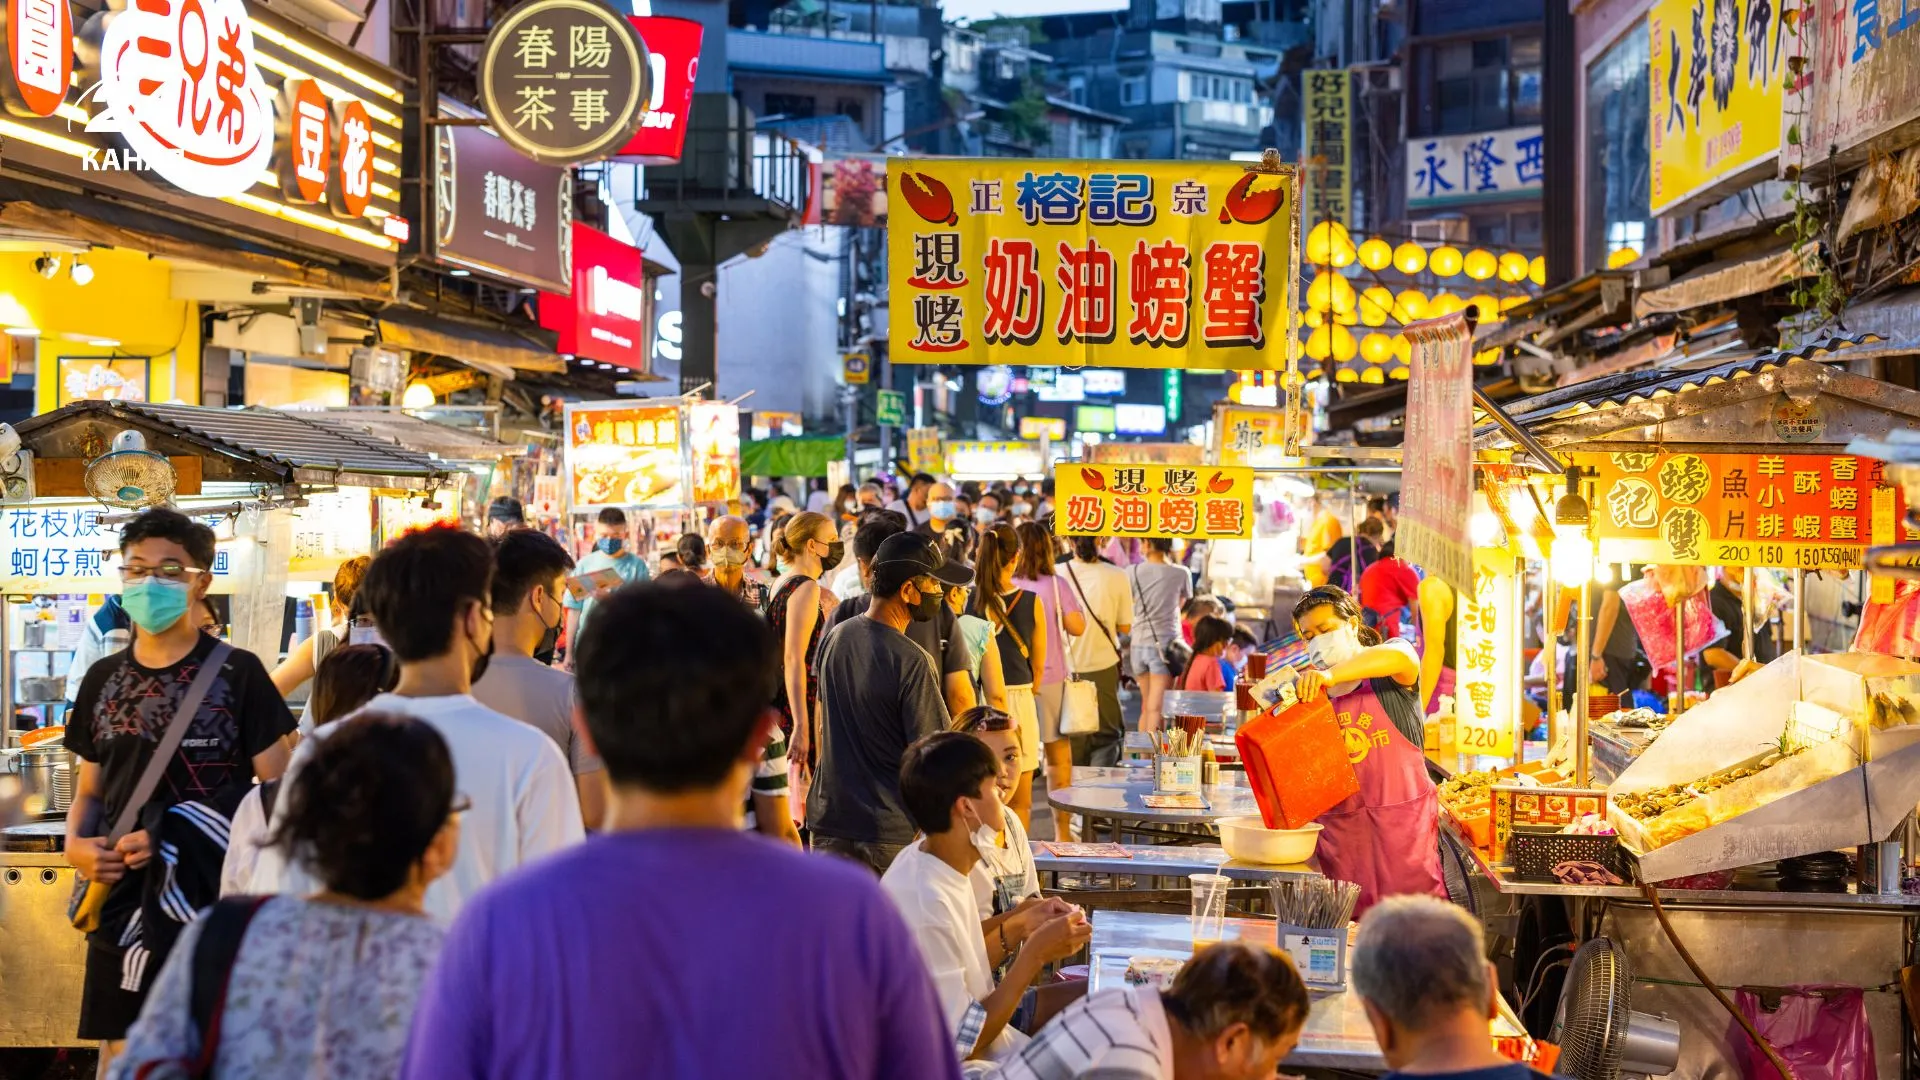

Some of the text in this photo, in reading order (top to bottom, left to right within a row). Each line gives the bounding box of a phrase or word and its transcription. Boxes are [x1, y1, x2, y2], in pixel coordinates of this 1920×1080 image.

[513, 25, 612, 69] 春陽
[513, 87, 611, 131] 茶事
[298, 100, 369, 197] 豆花
[483, 171, 536, 231] 春陽茶事
[972, 172, 1206, 225] 正 榕記 宗
[913, 233, 966, 346] 現烤
[983, 239, 1263, 343] 奶油螃蟹
[1114, 468, 1197, 494] 現烤
[1660, 456, 1702, 559] 螃蟹
[1722, 469, 1749, 538] 魚片
[1757, 455, 1785, 538] 羊小排
[1793, 470, 1822, 539] 酥蝦
[1830, 457, 1858, 539] 香螃蟹
[1066, 496, 1243, 532] 奶油螃蟹
[10, 548, 102, 576] 蚵仔煎
[1719, 546, 1750, 561] 200
[1758, 546, 1783, 563] 150
[1795, 549, 1819, 565] 150
[1463, 727, 1497, 748] 220
